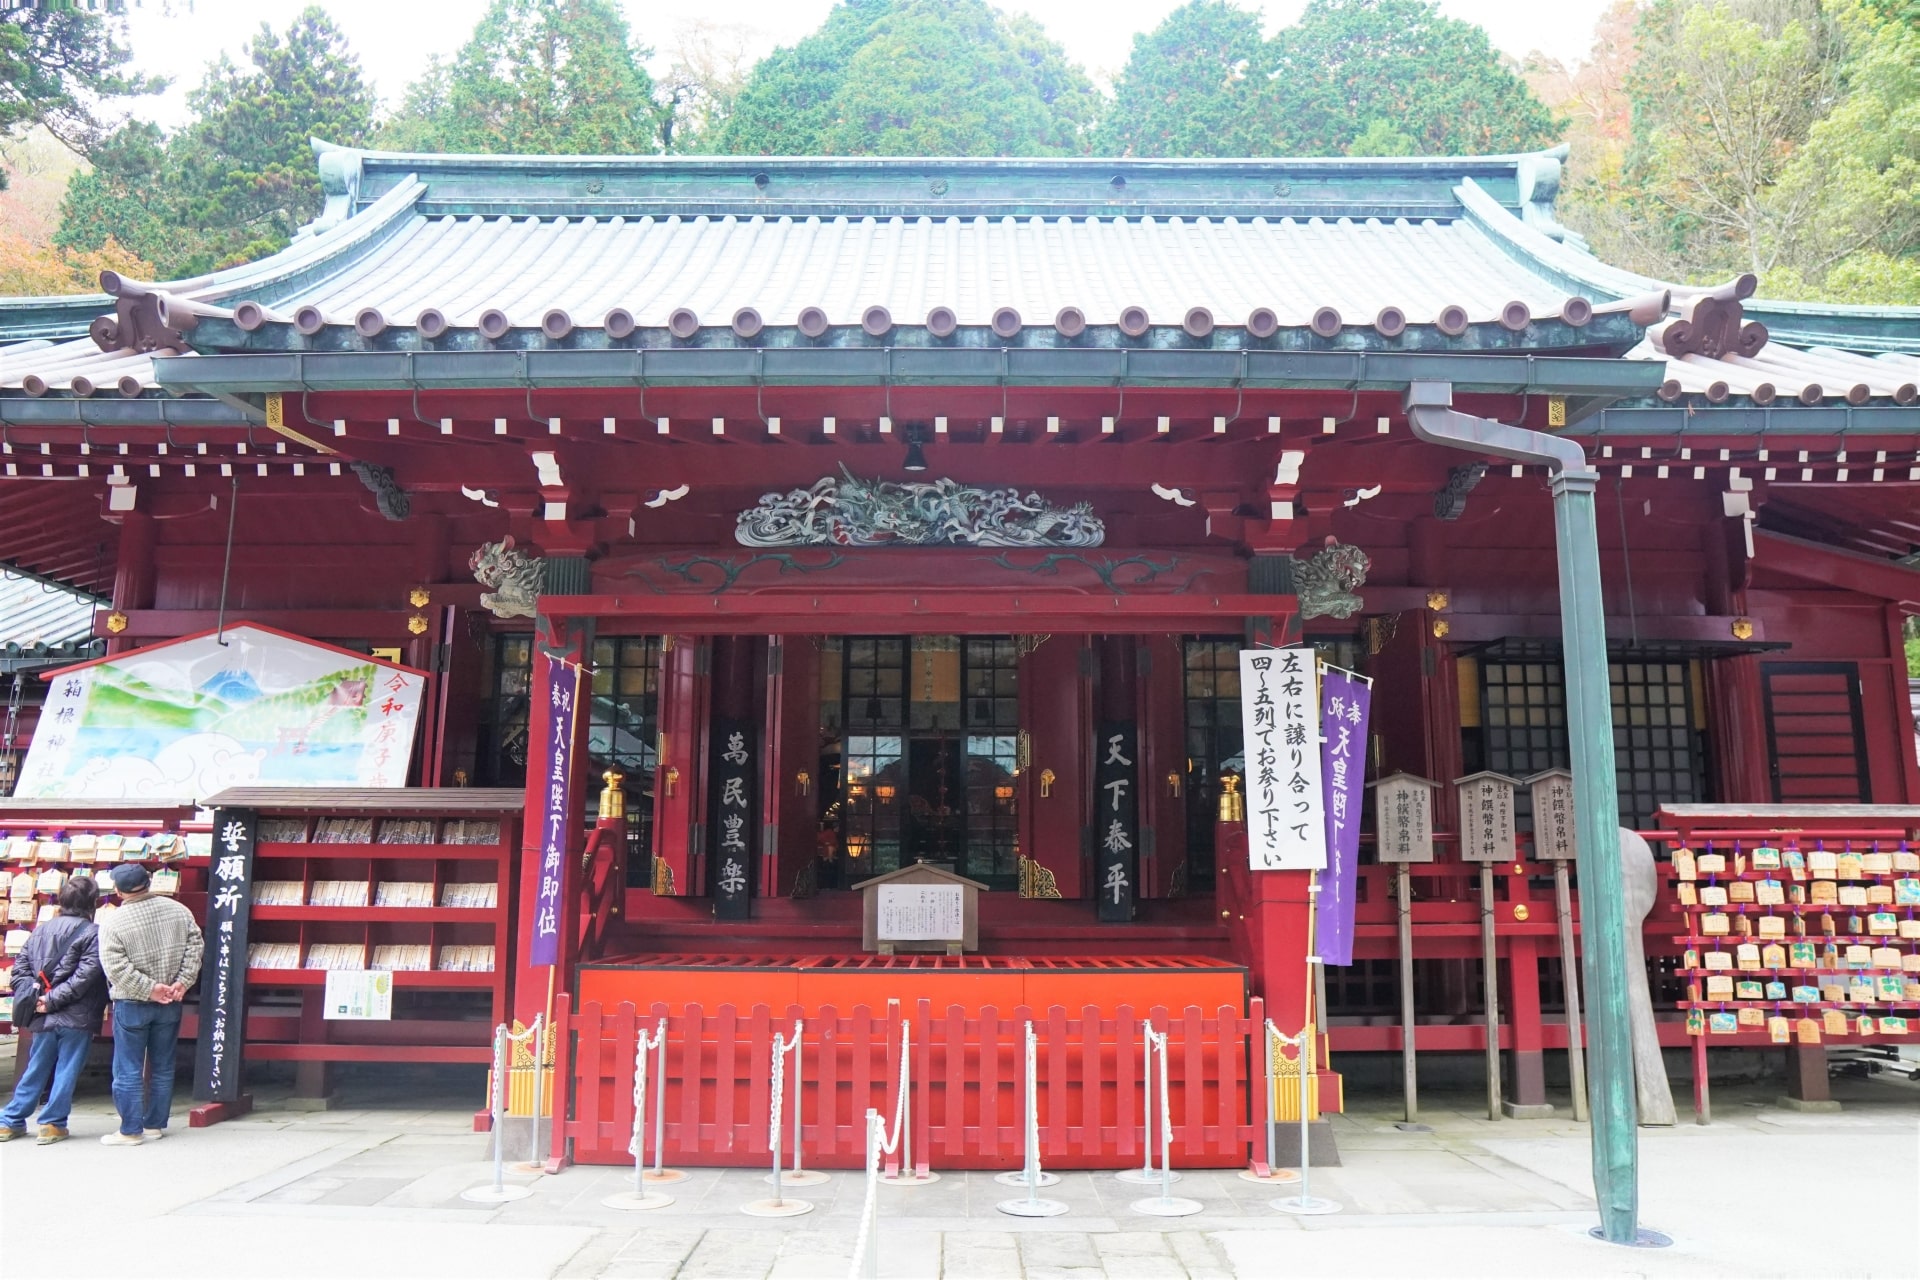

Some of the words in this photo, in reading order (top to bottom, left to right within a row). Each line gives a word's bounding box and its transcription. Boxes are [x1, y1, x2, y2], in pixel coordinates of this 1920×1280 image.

[37, 679, 82, 777] 箱根神社
[551, 681, 571, 712] 奉祝
[1280, 651, 1310, 841] 左右に譲り合って
[214, 821, 247, 915] 誓願所
[538, 716, 565, 938] 天皇陛下御即位
[1103, 734, 1132, 905] 天下泰平
